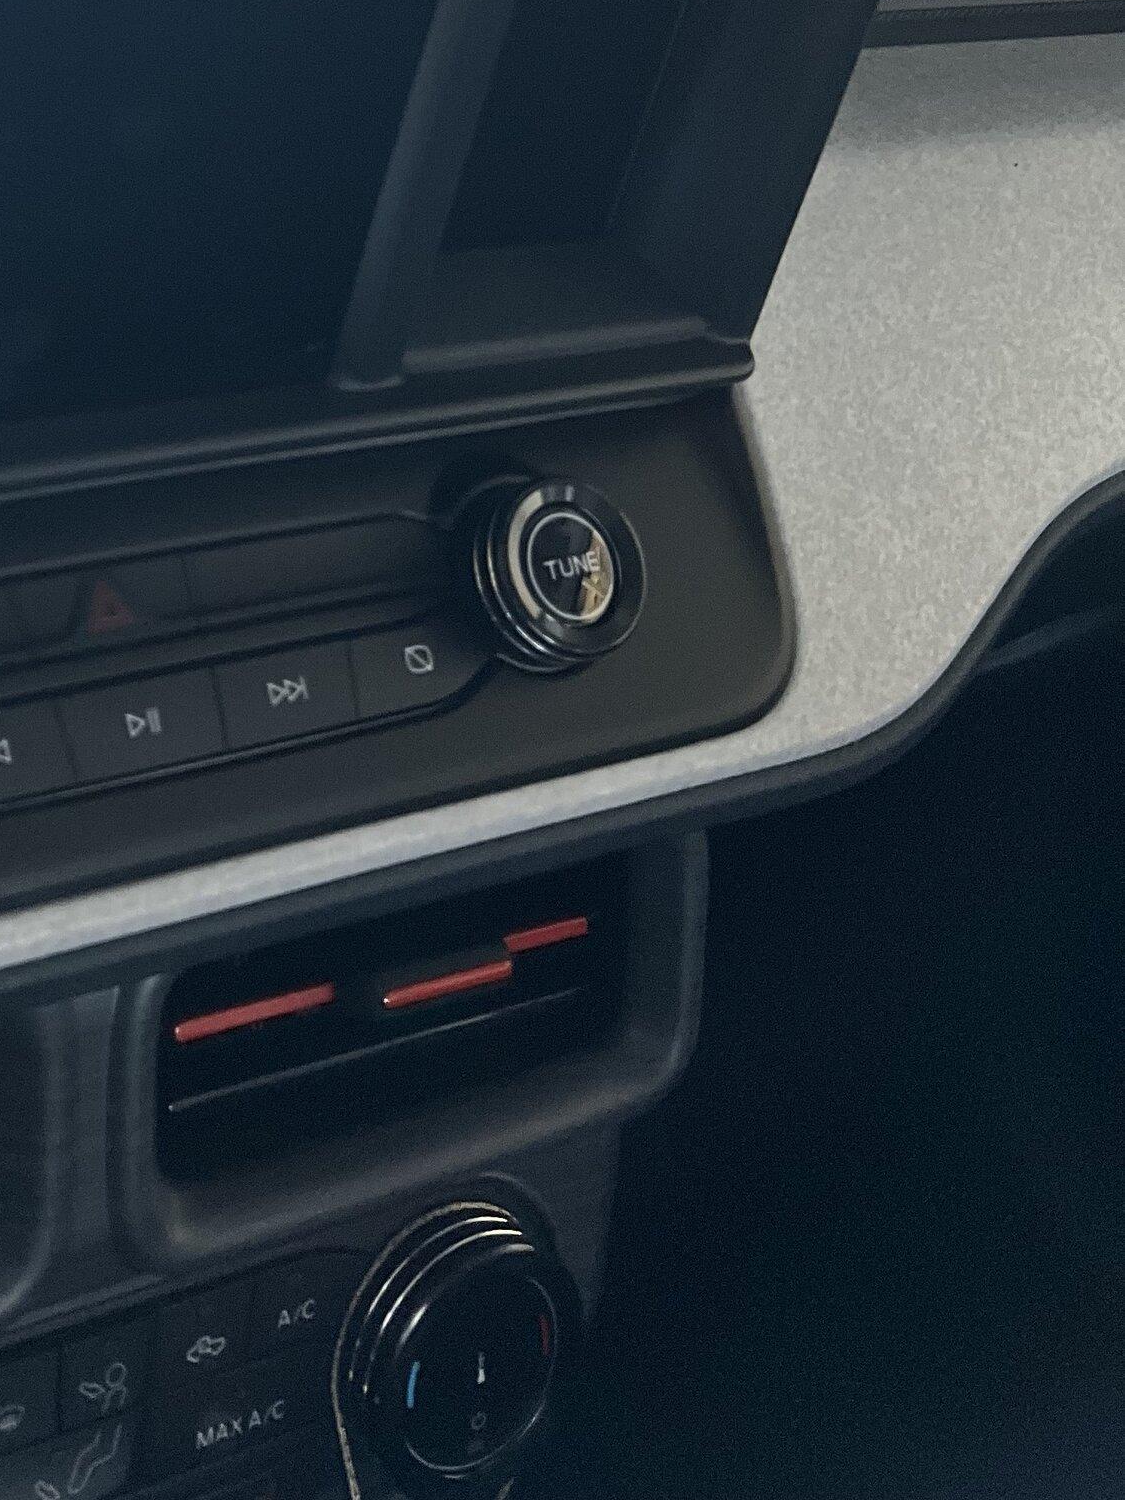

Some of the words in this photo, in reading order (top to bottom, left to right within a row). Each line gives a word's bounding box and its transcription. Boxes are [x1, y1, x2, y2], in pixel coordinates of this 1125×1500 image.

[542, 550, 601, 581] TUNE
[278, 1299, 316, 1328] A/C
[196, 1416, 243, 1450] MAX
[248, 1400, 285, 1429] A/C
